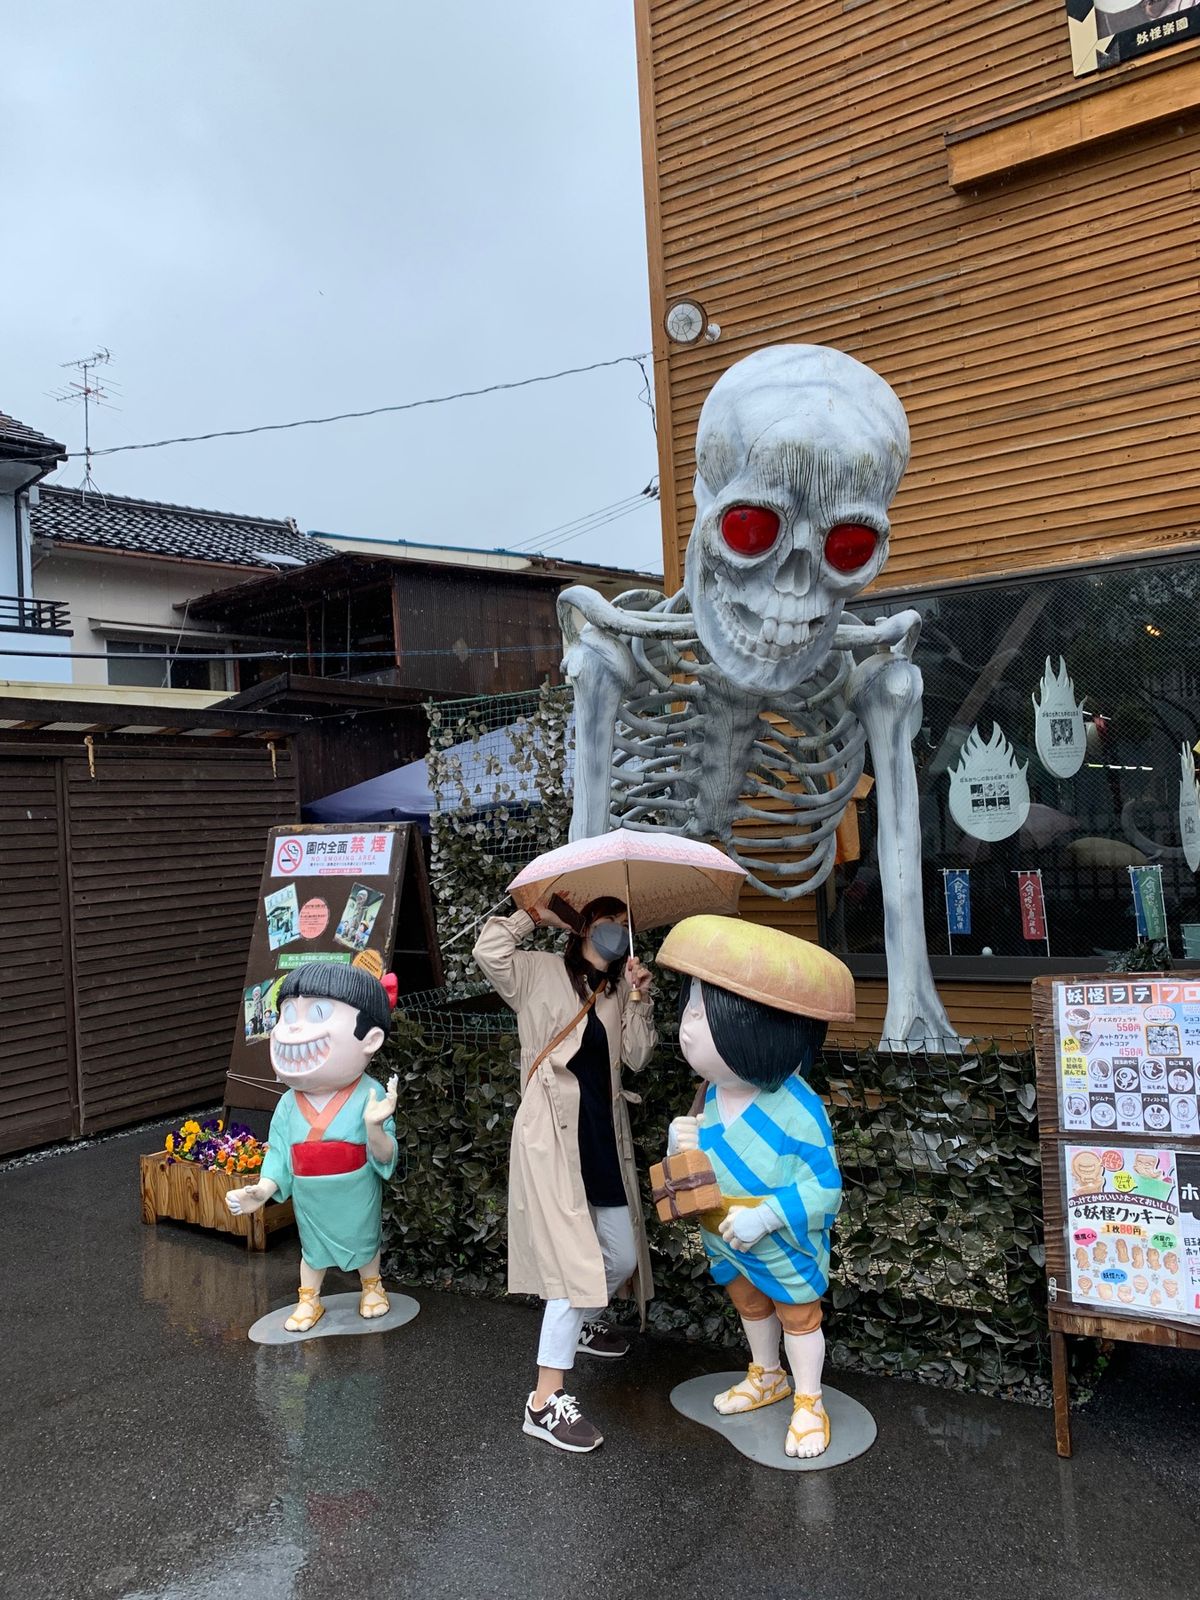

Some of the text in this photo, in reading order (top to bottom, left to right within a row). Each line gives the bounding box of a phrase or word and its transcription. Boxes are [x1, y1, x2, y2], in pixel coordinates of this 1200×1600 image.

[1136, 16, 1188, 46] 妖怪楽園
[306, 841, 348, 855] 園内全面
[1066, 987, 1150, 1003] 妖怪ラテ
[1117, 1023, 1141, 1032] 550円
[1119, 1047, 1143, 1056] 450円
[1181, 1183, 1200, 1201] ホ
[1083, 1205, 1166, 1224] 妖怪クッキー
[539, 1412, 560, 1431] N
